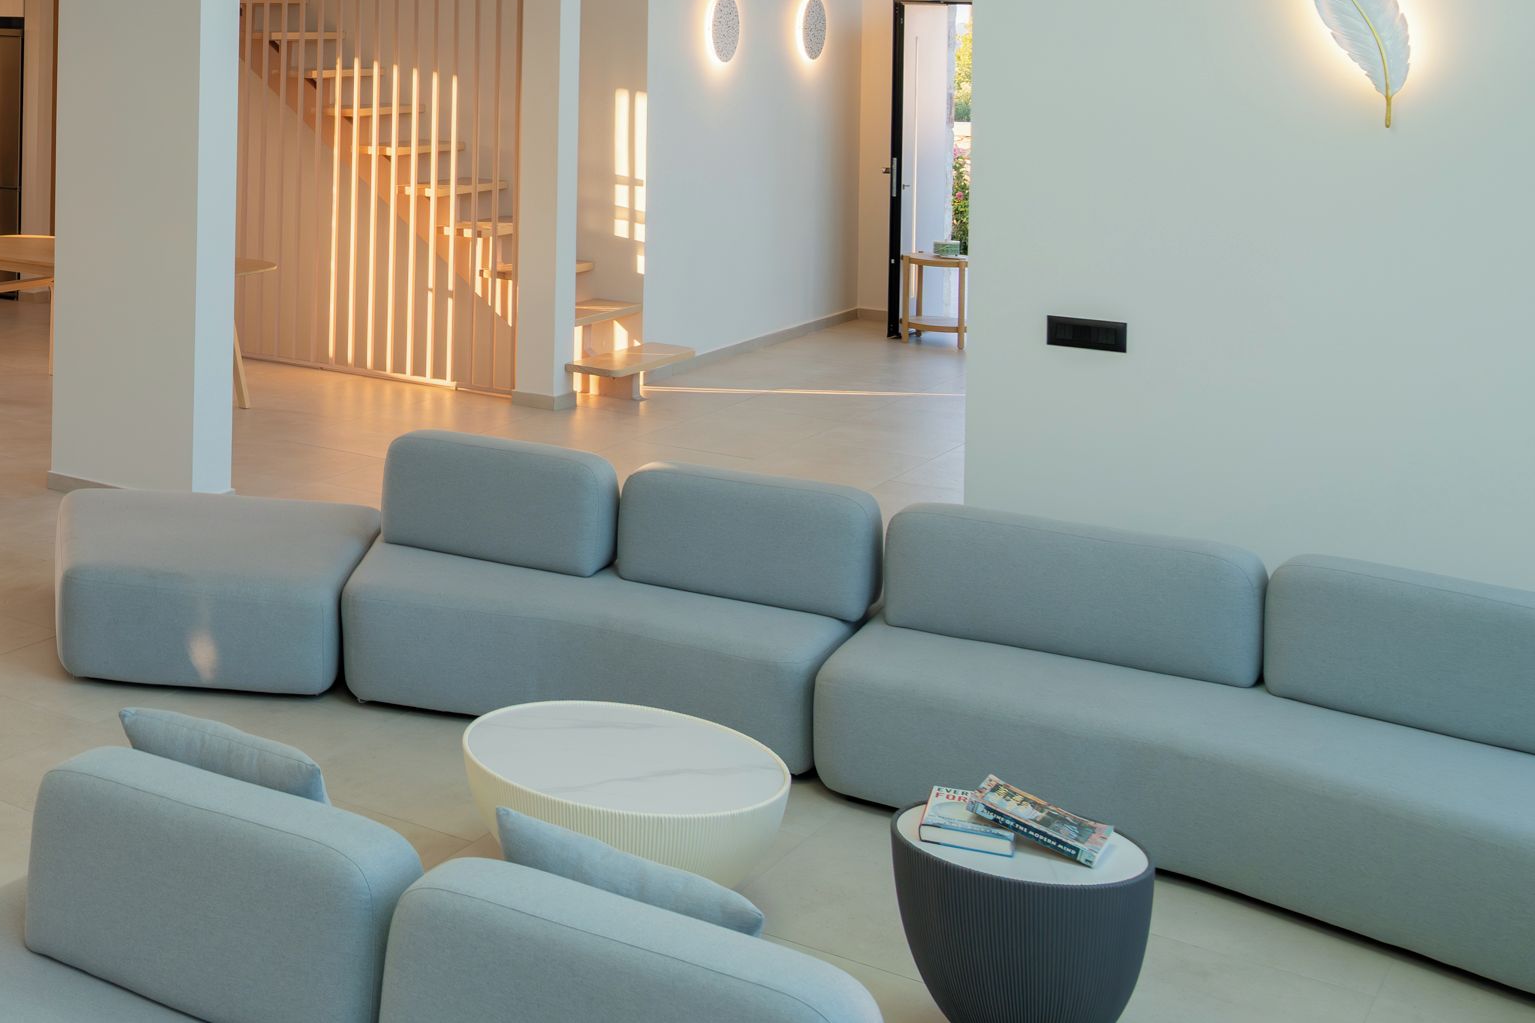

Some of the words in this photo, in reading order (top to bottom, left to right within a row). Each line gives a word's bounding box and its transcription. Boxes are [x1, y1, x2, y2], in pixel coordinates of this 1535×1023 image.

[935, 791, 969, 802] FOR
[1005, 819, 1014, 827] OF
[1015, 823, 1028, 833] THE
[1028, 830, 1057, 846] MODERN
[1057, 843, 1077, 855] MIND
